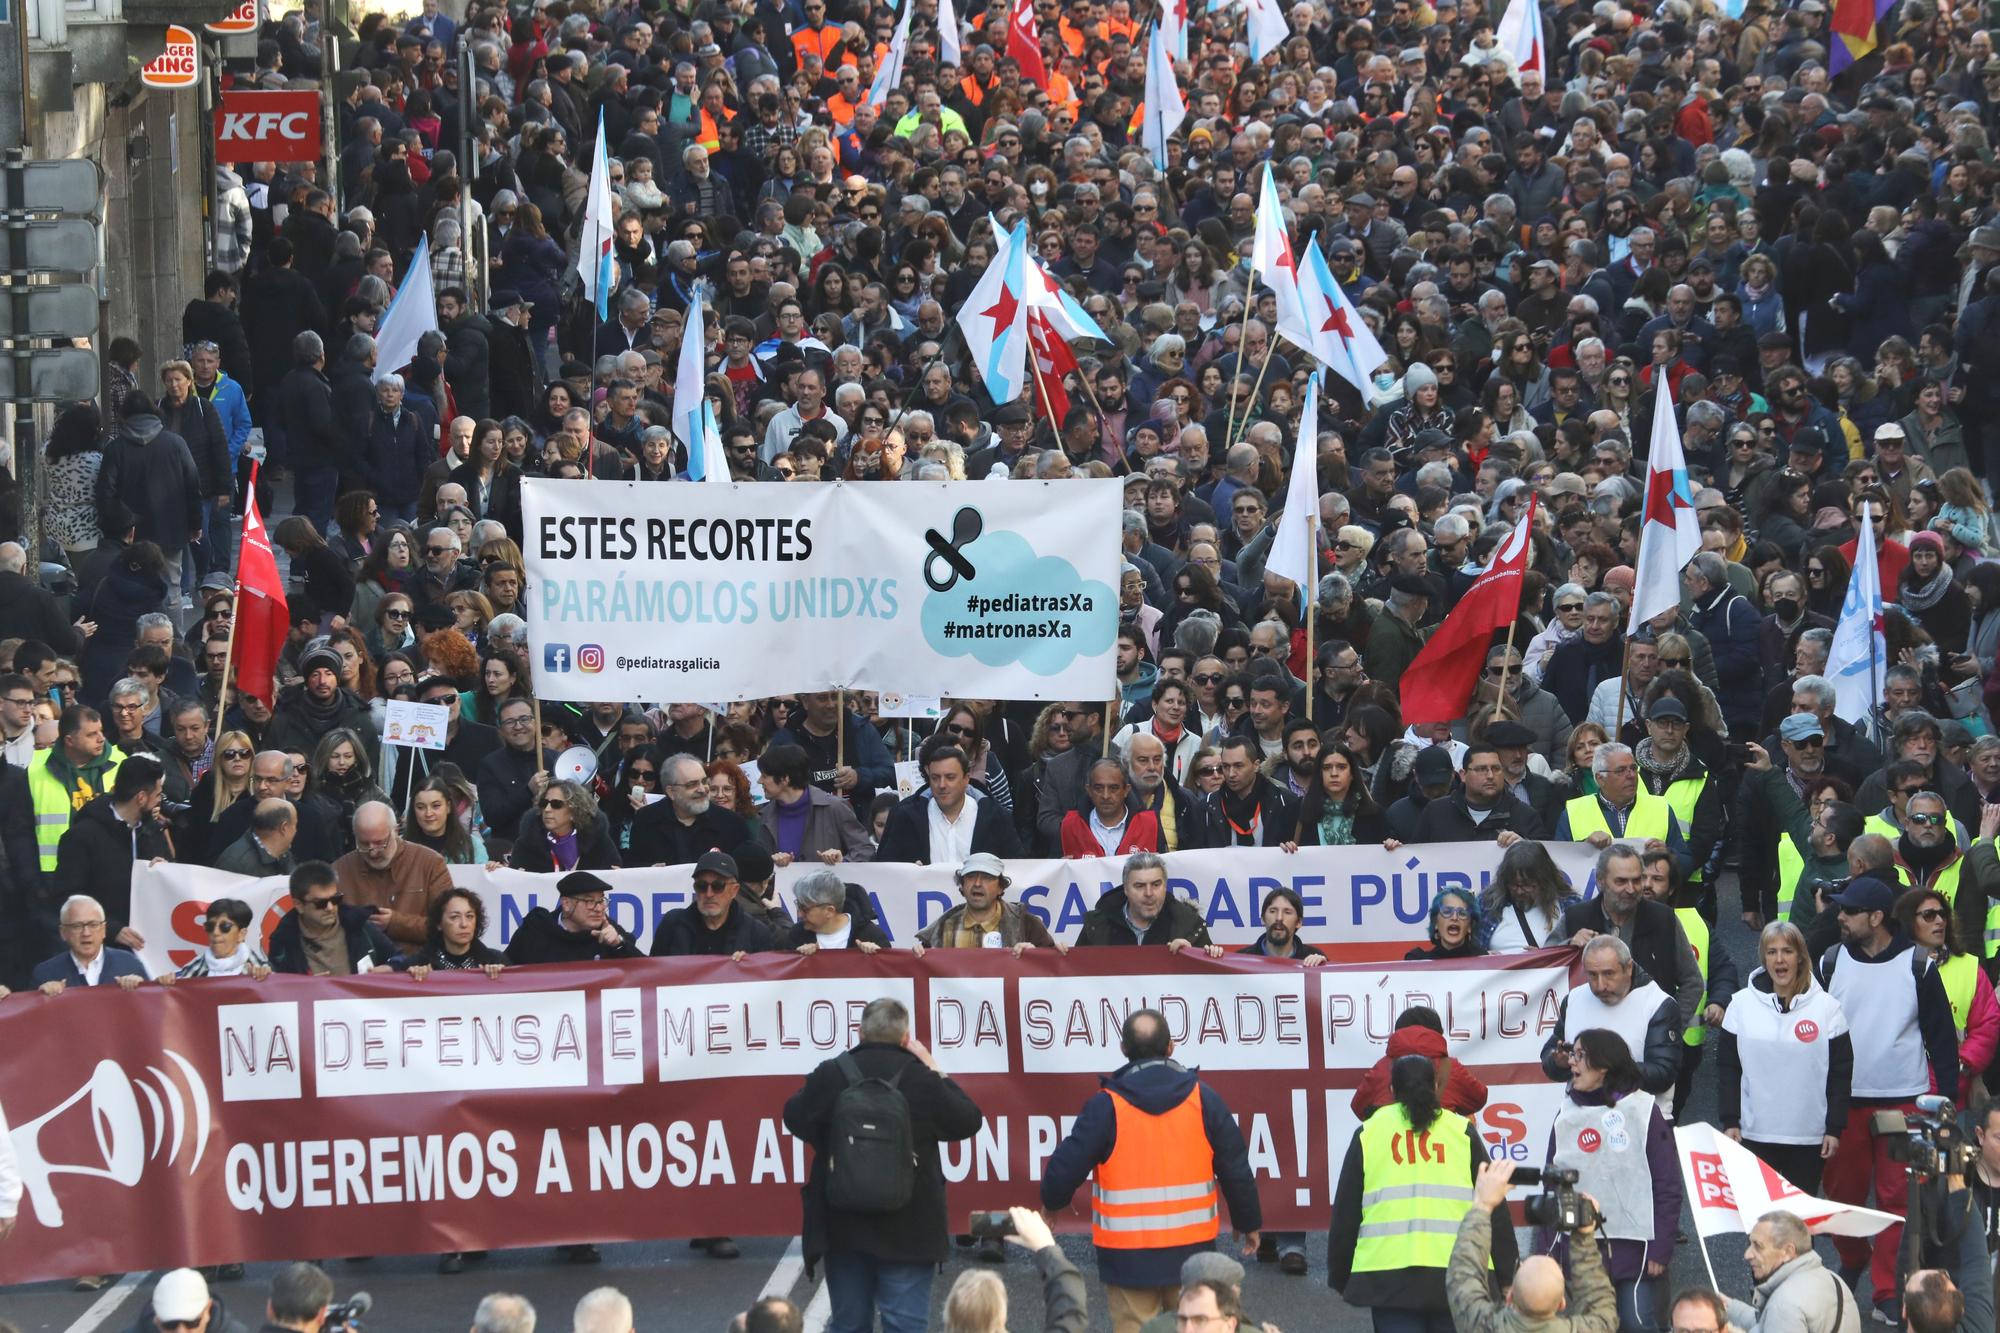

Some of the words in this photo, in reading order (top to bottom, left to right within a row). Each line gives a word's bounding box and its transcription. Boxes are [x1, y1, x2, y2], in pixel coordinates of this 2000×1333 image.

[219, 113, 308, 140] KFC
[540, 516, 637, 560] ESTES
[647, 518, 813, 561] RECORTES
[542, 571, 758, 624] PARÁMOLOS
[769, 577, 899, 621] UNIDXS
[967, 593, 1093, 617] #pediatrasXa
[944, 620, 1071, 638] #matronasXa
[616, 655, 721, 672] @pediatrasgalicia
[224, 1025, 295, 1077] NA
[322, 1013, 583, 1071] DEFENSA
[610, 1009, 637, 1060] E
[936, 996, 1003, 1049] DA
[1024, 993, 1302, 1049] SANDADE
[1391, 1130, 1446, 1165] CIG
[224, 1129, 519, 1215] QUEREMOS
[535, 1128, 573, 1194] A
[588, 1119, 736, 1191] NOSA
